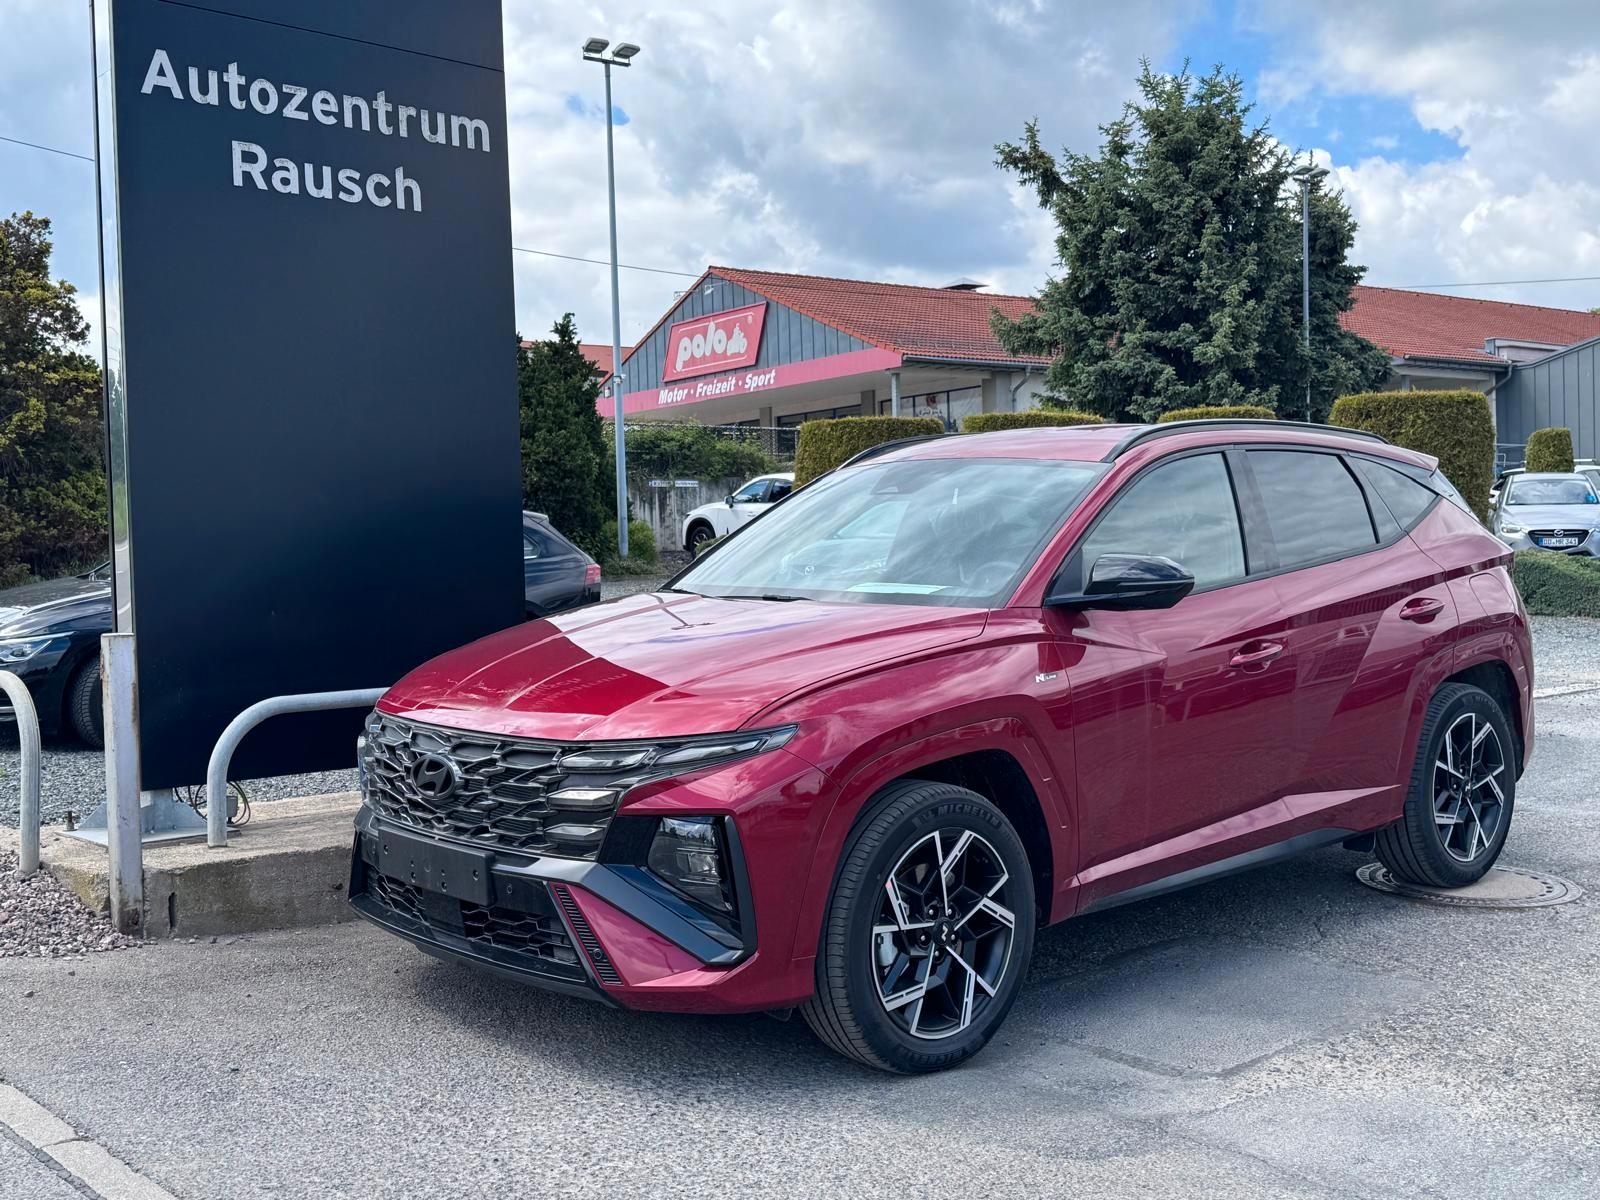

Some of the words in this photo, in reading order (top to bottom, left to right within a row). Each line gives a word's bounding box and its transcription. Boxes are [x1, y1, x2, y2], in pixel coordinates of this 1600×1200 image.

[140, 48, 491, 152] Autozentrum
[231, 140, 422, 212] Rausch
[675, 321, 728, 372] polo
[658, 388, 688, 405] Motor
[695, 377, 736, 398] Freizeit
[744, 368, 776, 392] Sport
[936, 804, 1000, 827] MICHELIN
